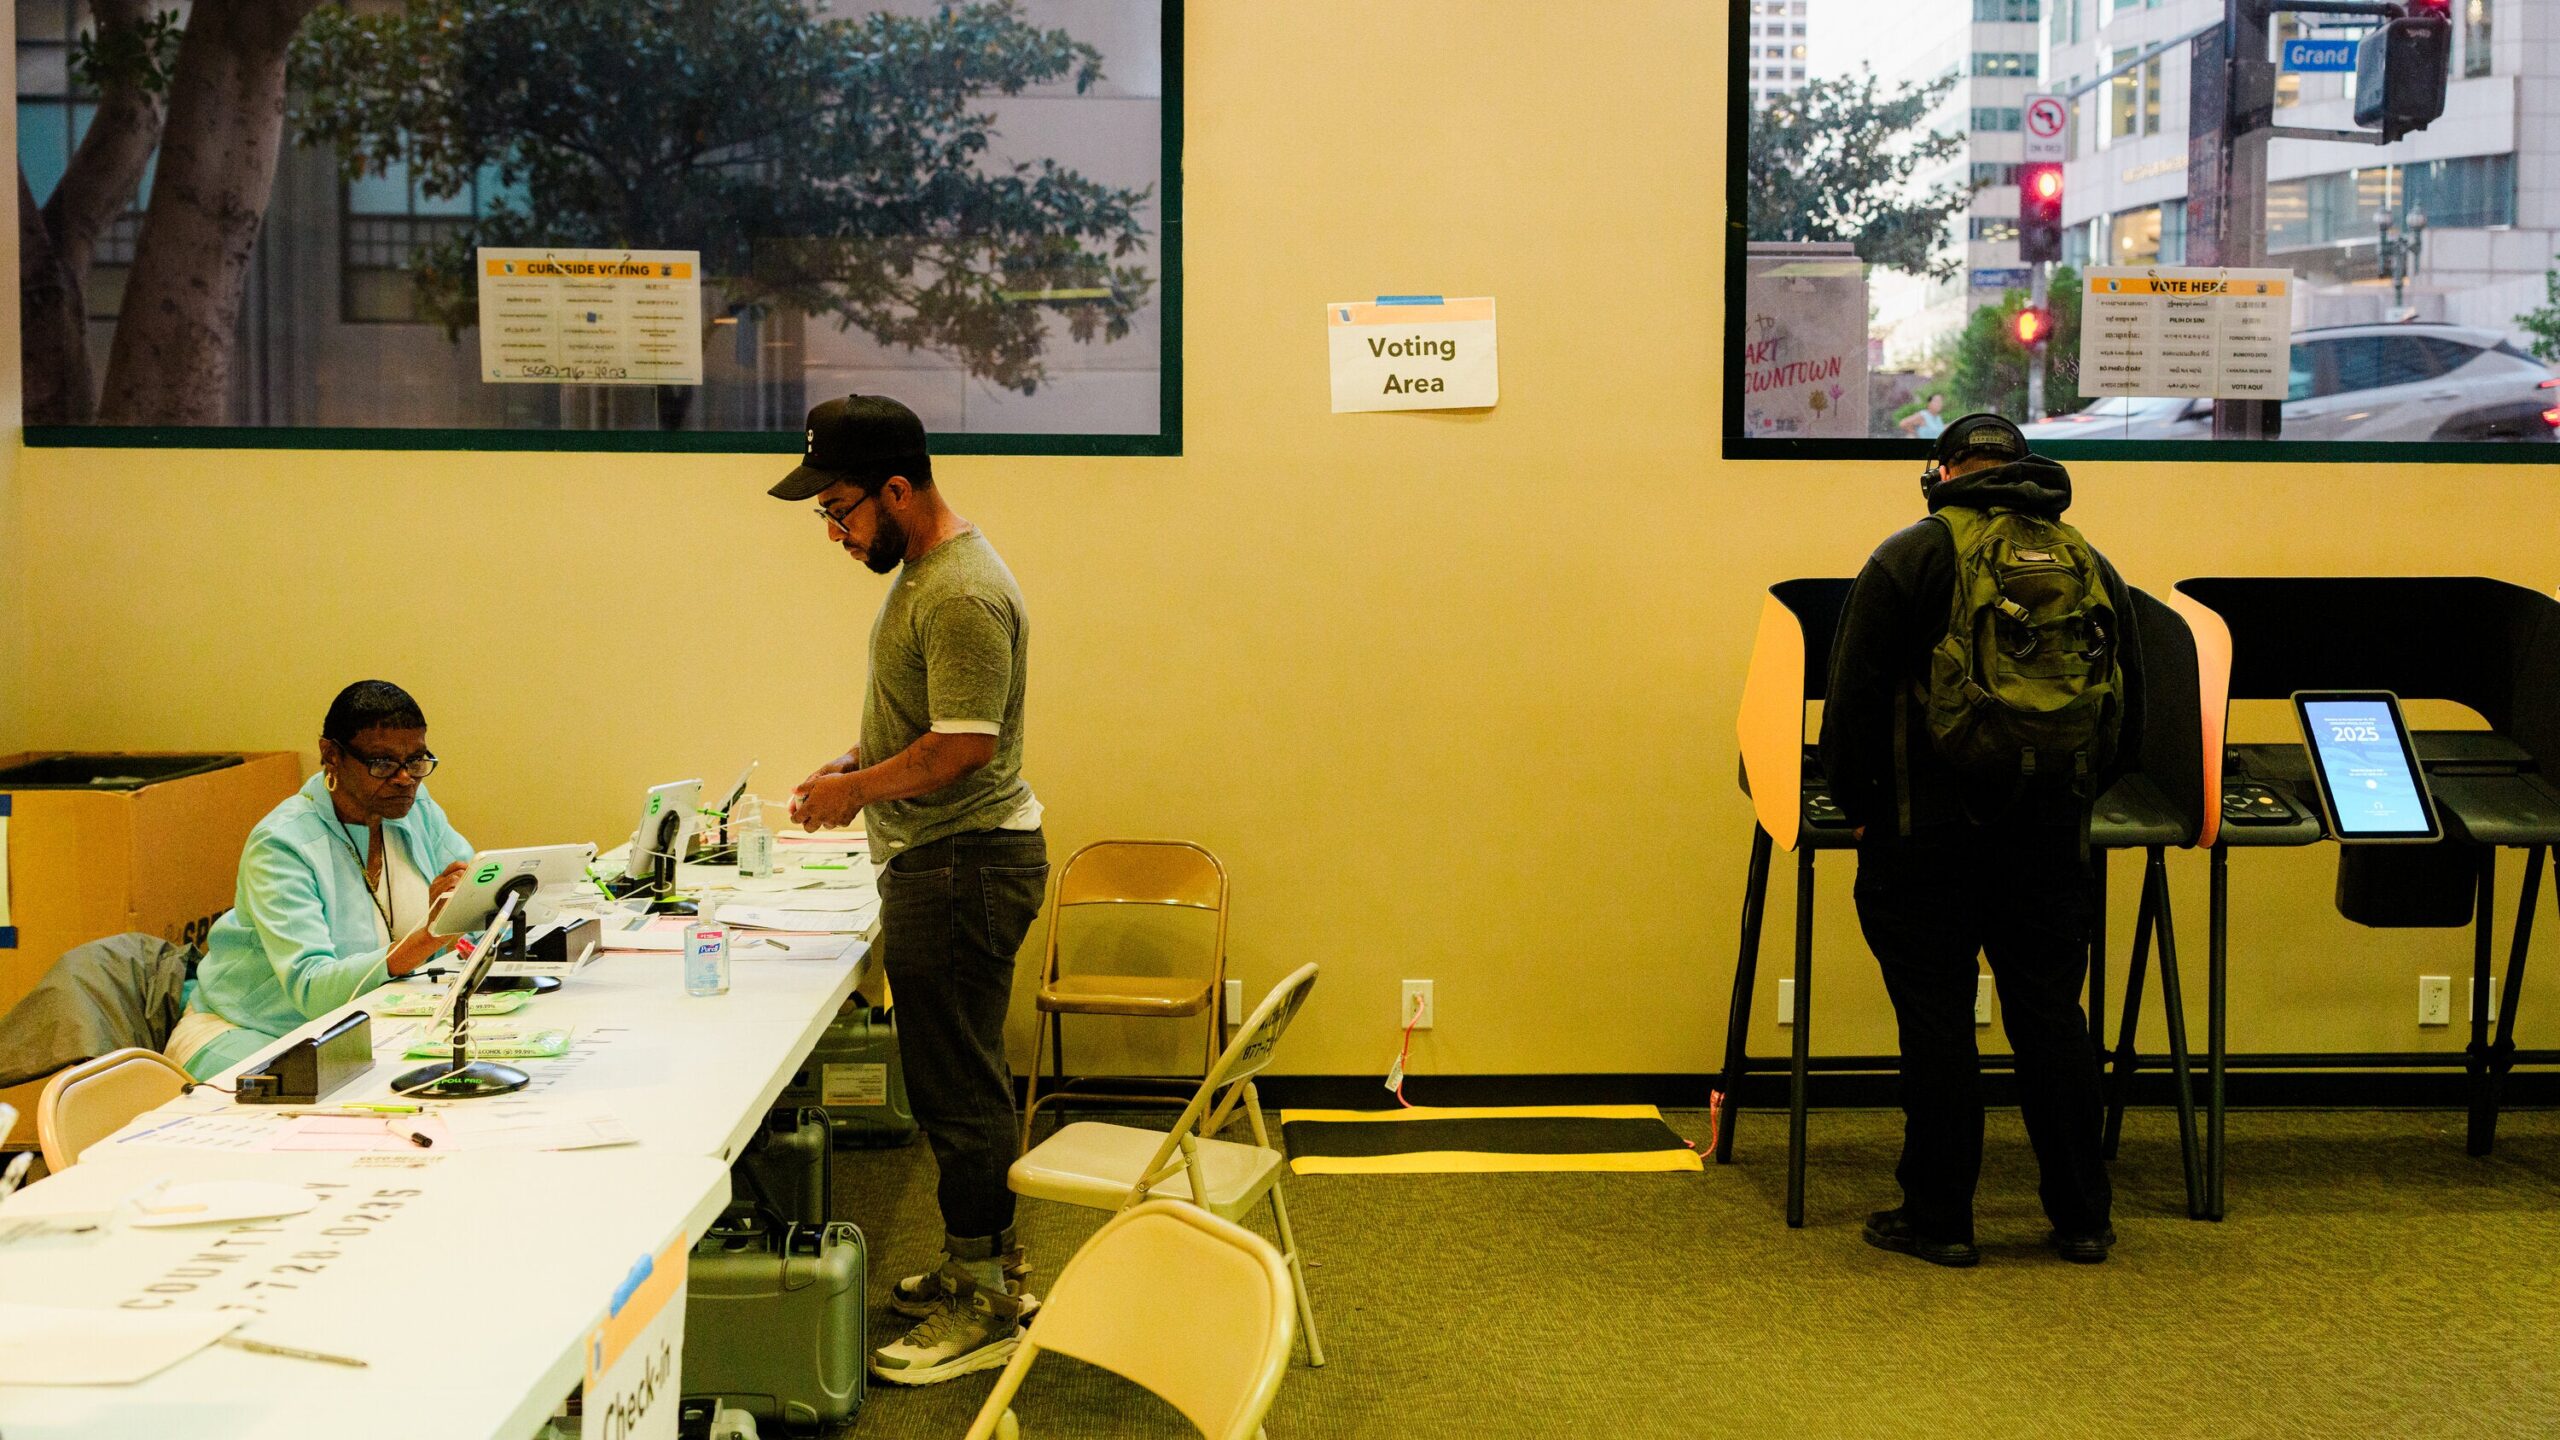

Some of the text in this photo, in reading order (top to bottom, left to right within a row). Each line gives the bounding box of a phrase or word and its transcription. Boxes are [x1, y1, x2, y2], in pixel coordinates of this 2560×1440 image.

[2291, 45, 2349, 65] Grand
[2150, 281, 2228, 293] VOTE HERE
[1367, 335, 1456, 361] Voting
[1383, 374, 1444, 395] Area
[2332, 726, 2380, 742] 2025
[477, 865, 499, 883] 10
[441, 1077, 483, 1085] POLL PAD
